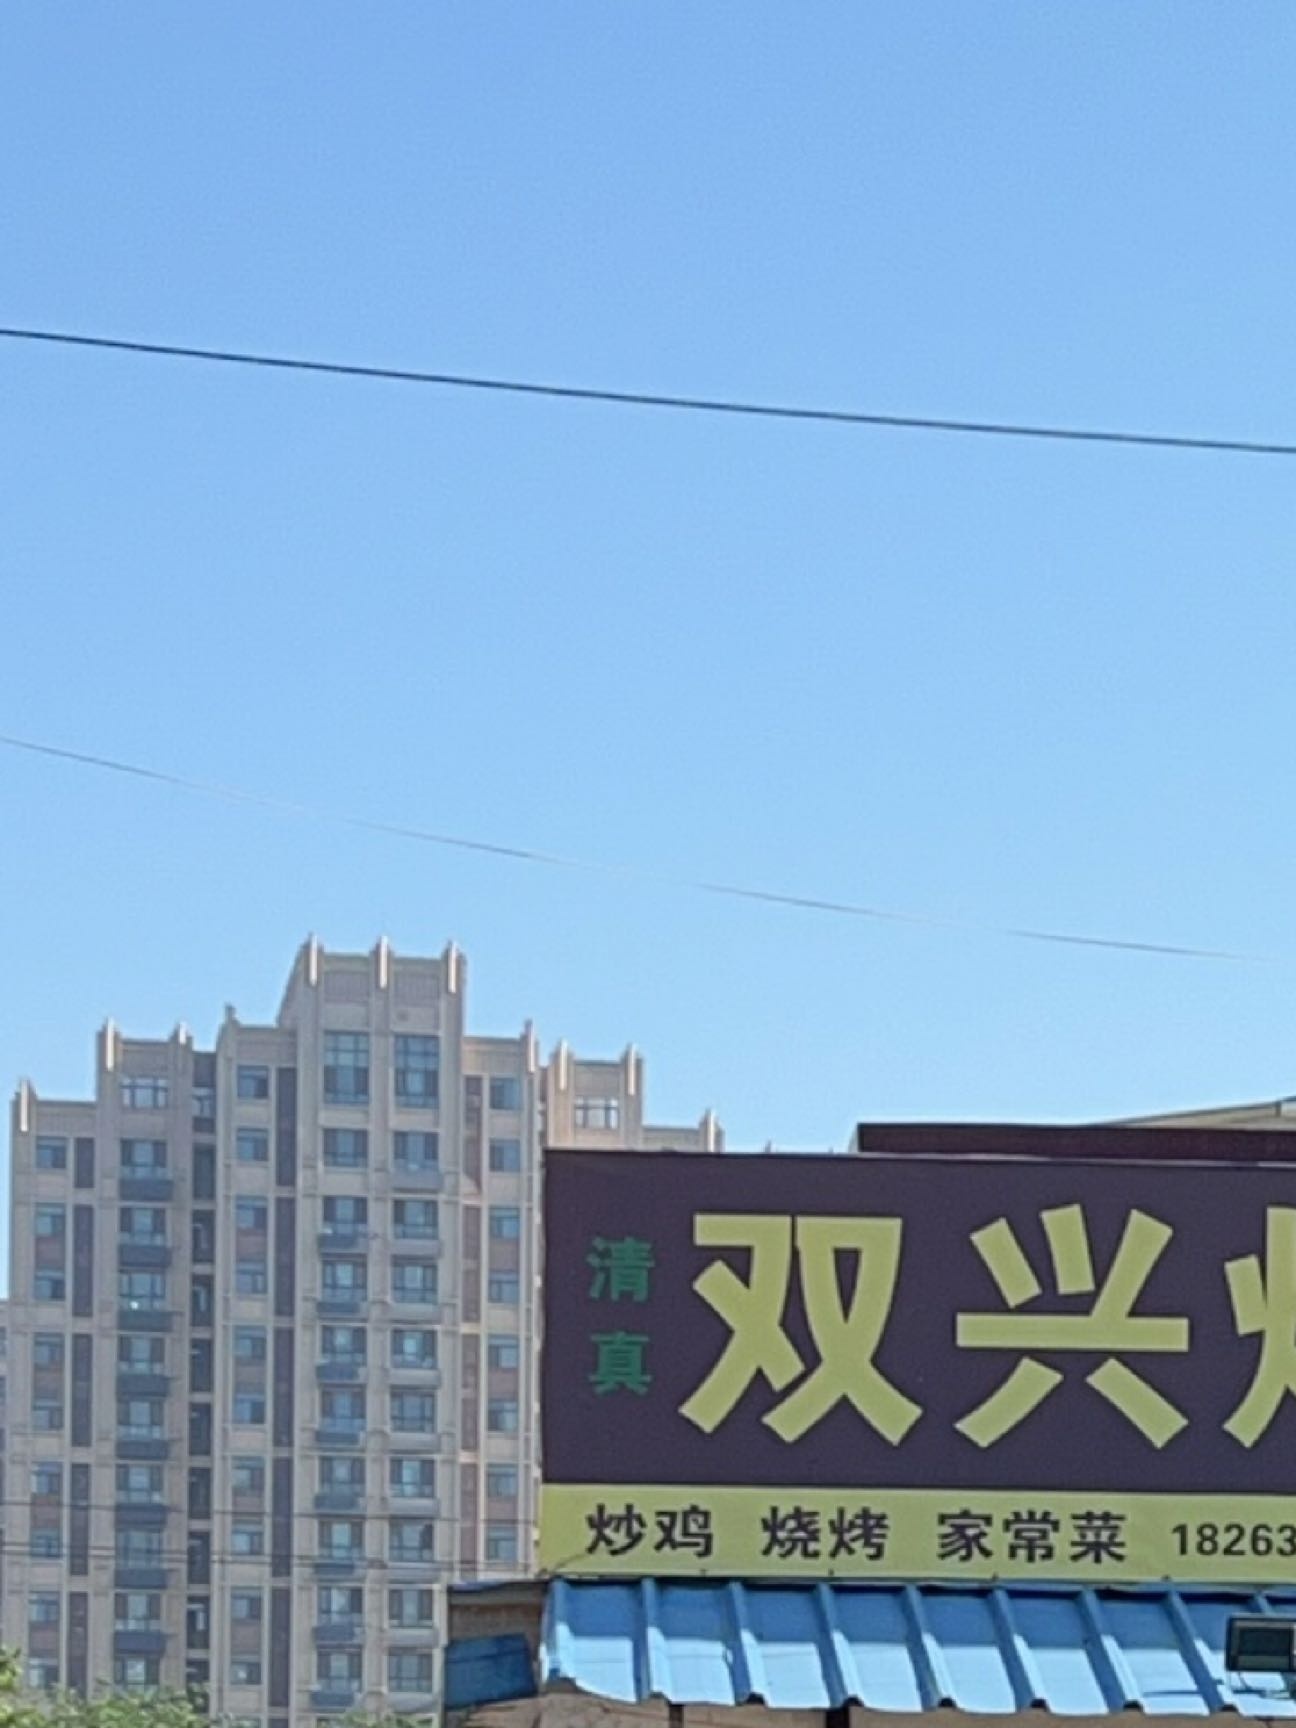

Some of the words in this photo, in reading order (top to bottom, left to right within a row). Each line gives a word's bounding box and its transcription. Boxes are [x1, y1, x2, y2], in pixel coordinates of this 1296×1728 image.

[586, 1235, 655, 1396] 清真
[585, 1503, 714, 1558] 炒鸡
[761, 1506, 890, 1562] 烧烤
[936, 1509, 1128, 1564] 家常菜
